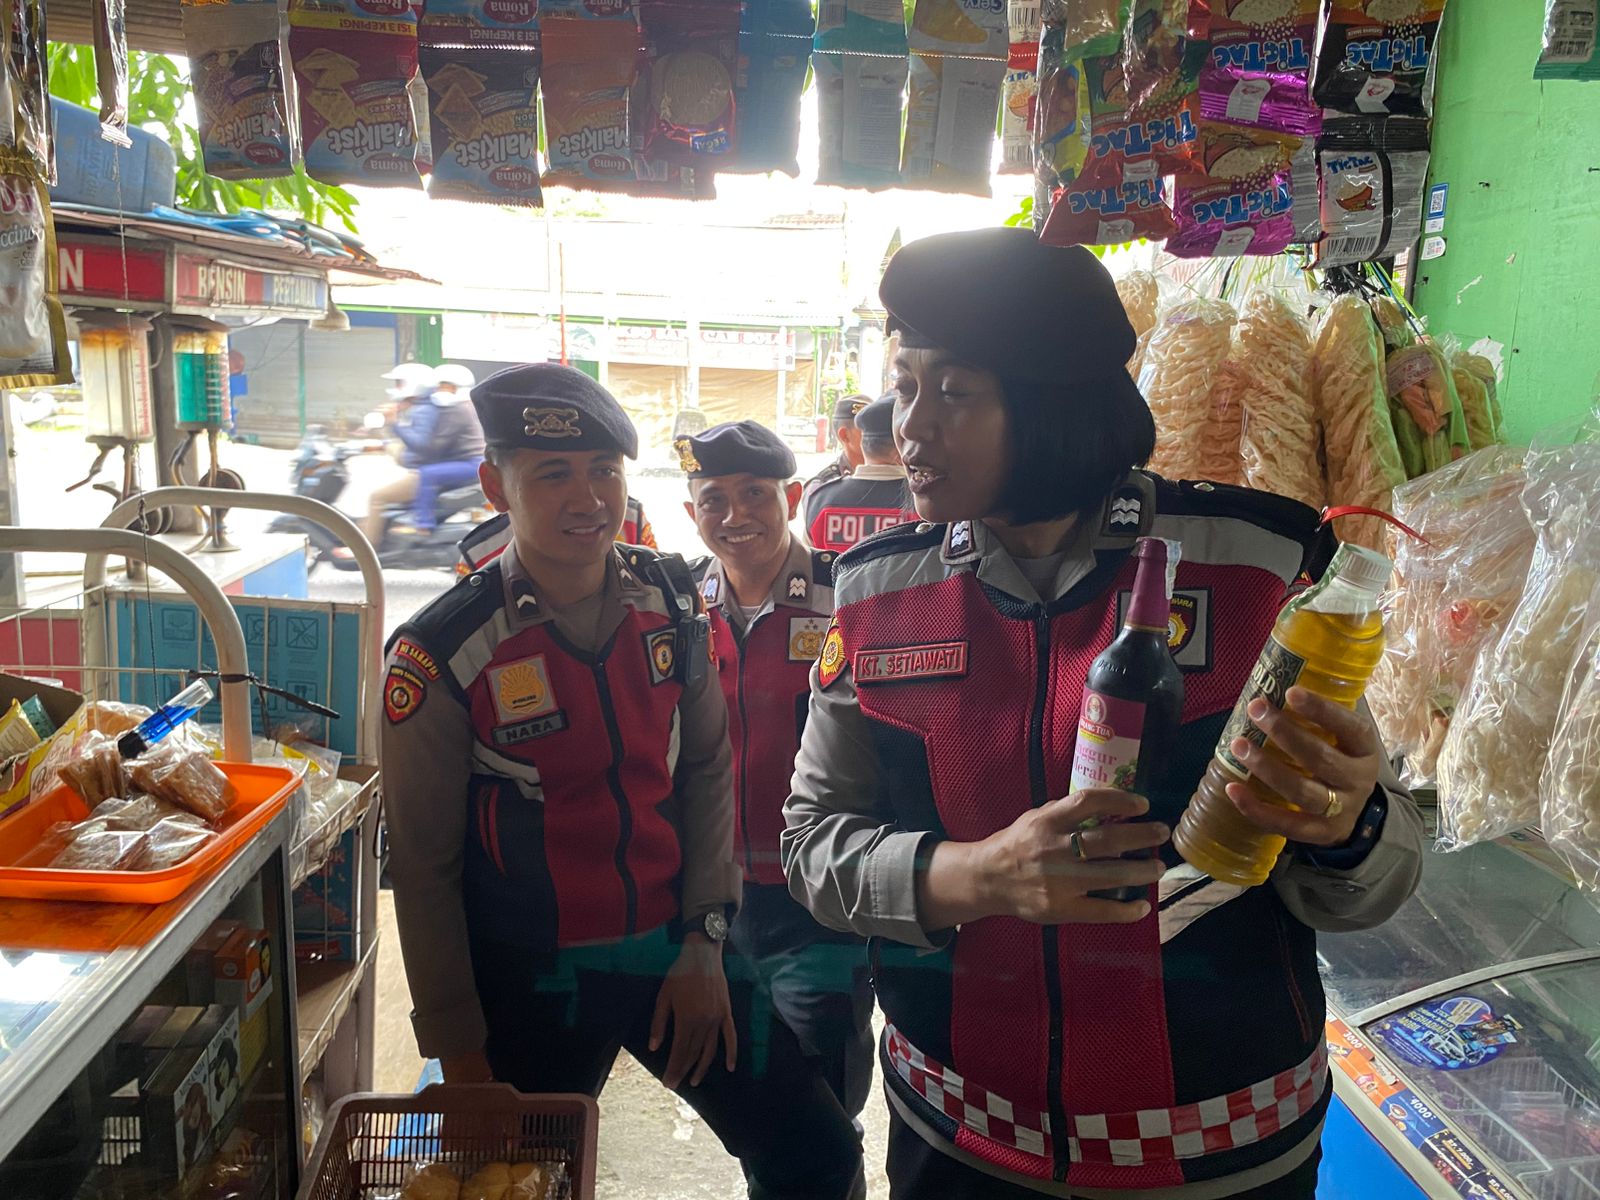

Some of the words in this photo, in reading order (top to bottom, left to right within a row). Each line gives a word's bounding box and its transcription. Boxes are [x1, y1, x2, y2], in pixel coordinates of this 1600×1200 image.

[490, 1, 529, 16] Roma
[216, 112, 280, 148] Malkist
[327, 120, 414, 154] Malkist
[455, 133, 536, 169] Malkist
[559, 126, 630, 159] Malkist
[694, 135, 728, 151] REGAL
[369, 158, 411, 172] Roma
[594, 158, 627, 171] Roma
[495, 171, 532, 186] Roma
[197, 264, 247, 306] BENSIN
[861, 657, 882, 677] KT.
[886, 649, 959, 675] SETIAWATI
[1252, 662, 1277, 695] OLD
[505, 718, 553, 741] NARA
[1075, 744, 1118, 766] nggur
[1410, 1097, 1433, 1119] 4000
